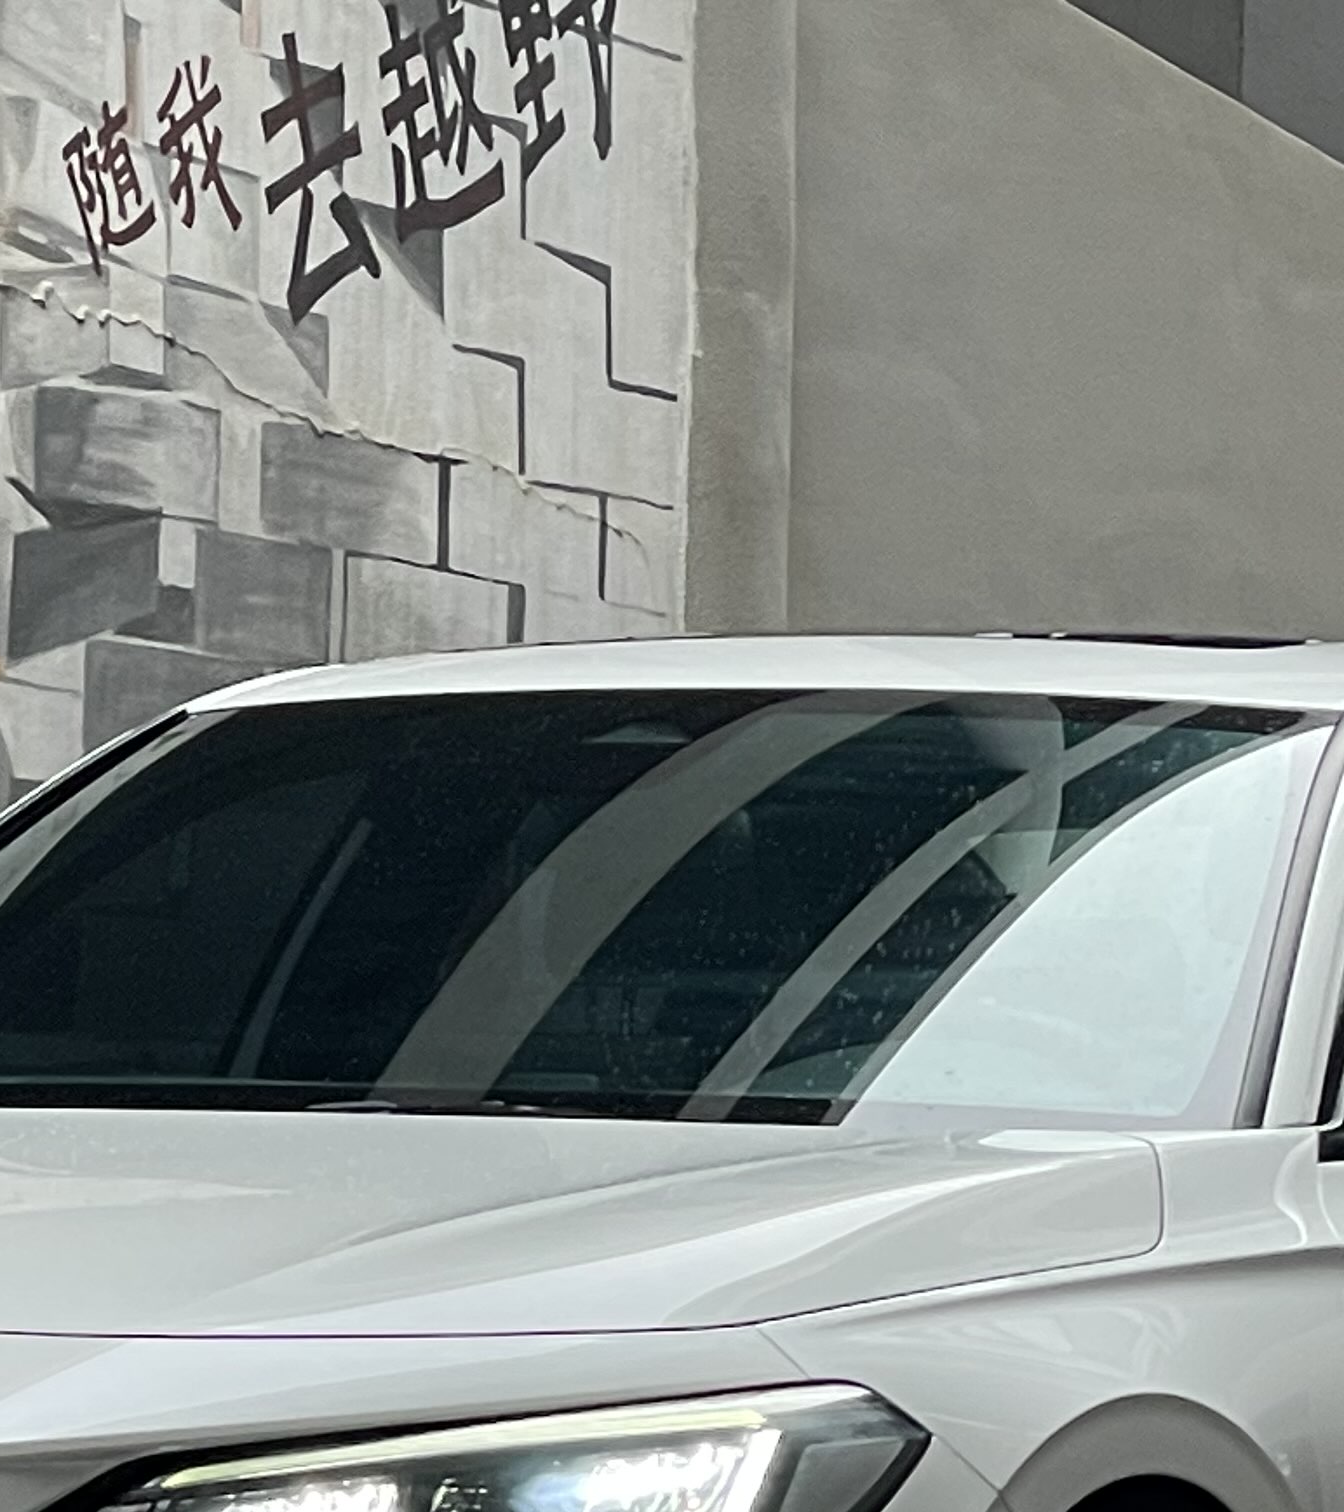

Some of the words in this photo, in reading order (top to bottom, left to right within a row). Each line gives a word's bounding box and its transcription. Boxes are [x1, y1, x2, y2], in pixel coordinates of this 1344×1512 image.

[62, 0, 615, 324] 随我去越野
